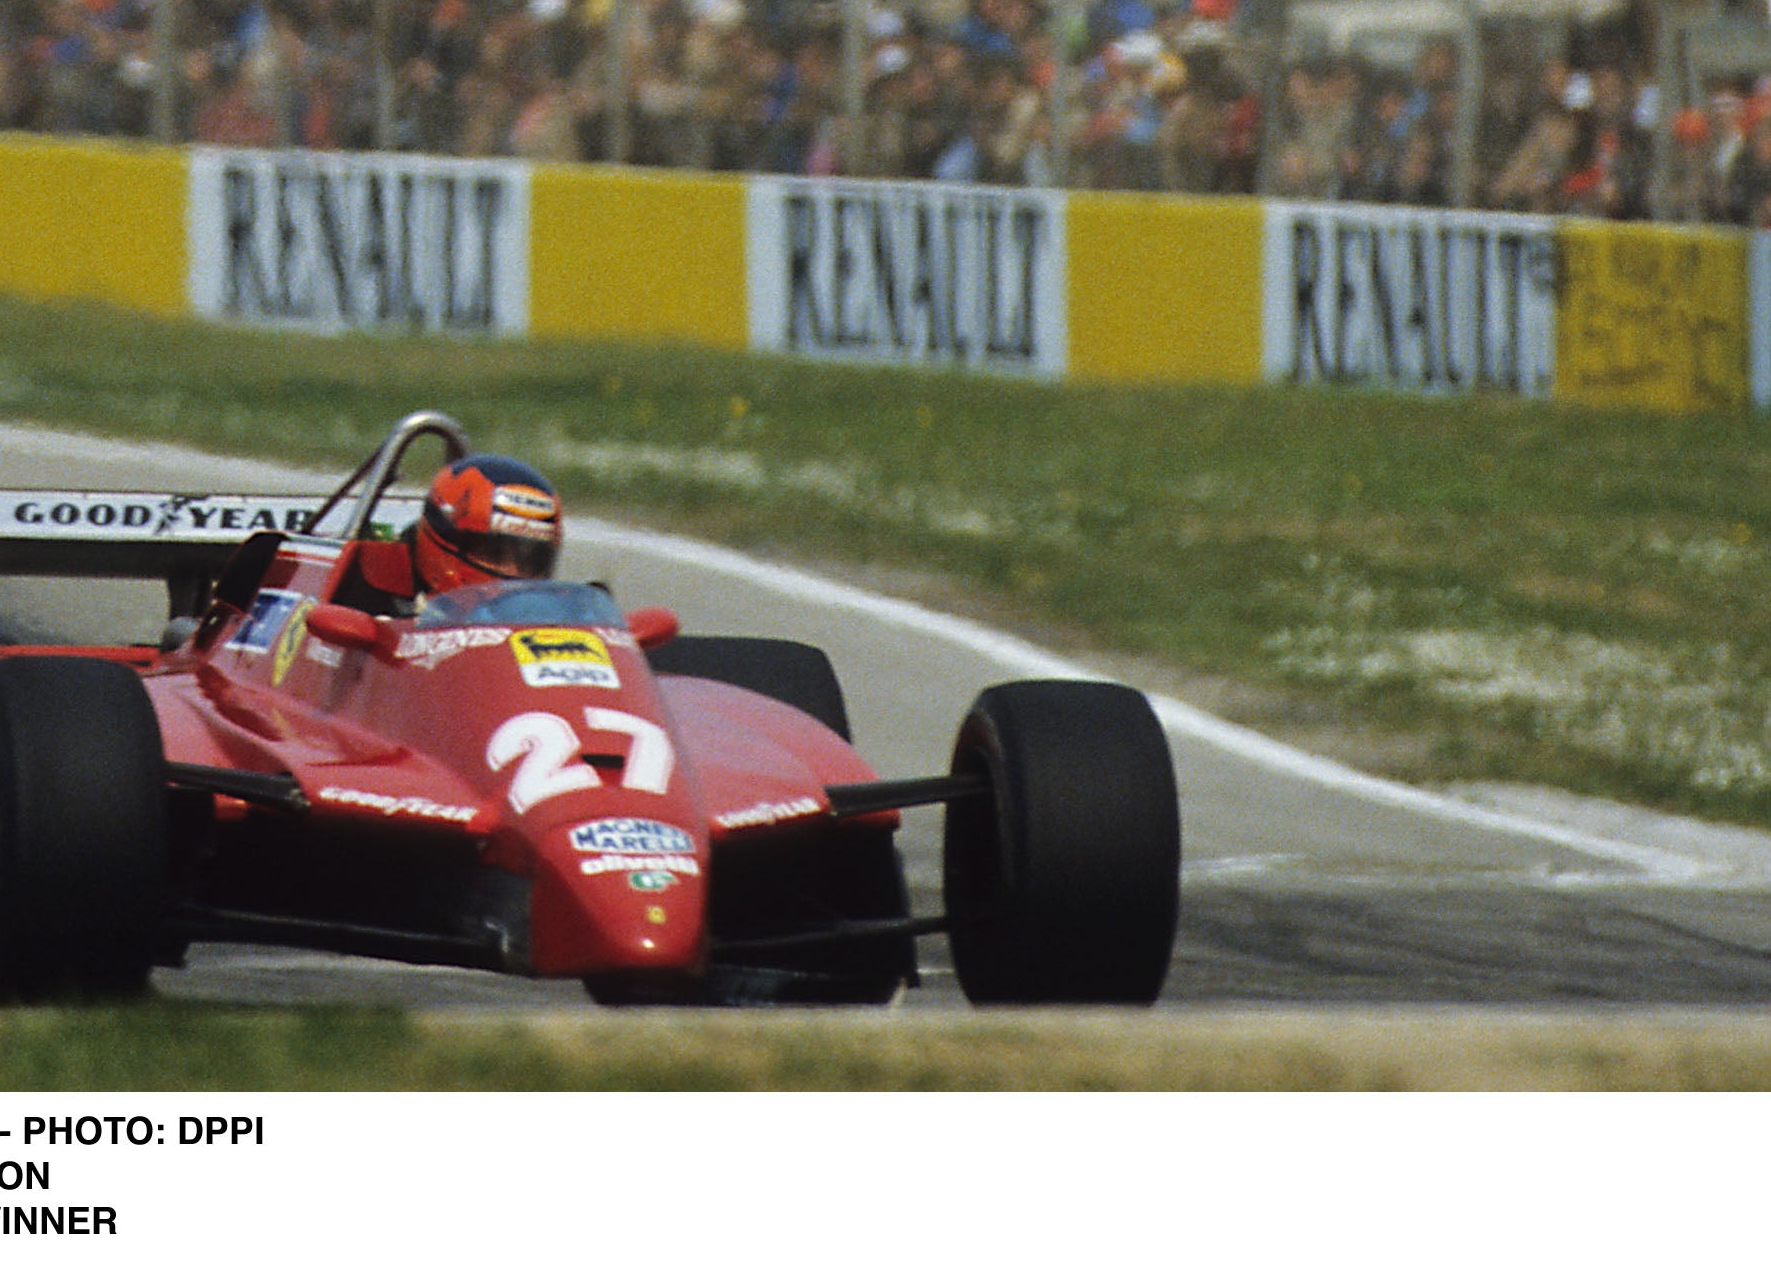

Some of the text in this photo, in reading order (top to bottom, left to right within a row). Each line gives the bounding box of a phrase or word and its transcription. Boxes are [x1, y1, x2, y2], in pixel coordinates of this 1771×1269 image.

[224, 170, 502, 326] RENAULT
[784, 196, 1046, 357] RENAULT
[1293, 219, 1527, 392] RENAULT
[13, 502, 151, 527] GOOD
[486, 706, 676, 814] 27
